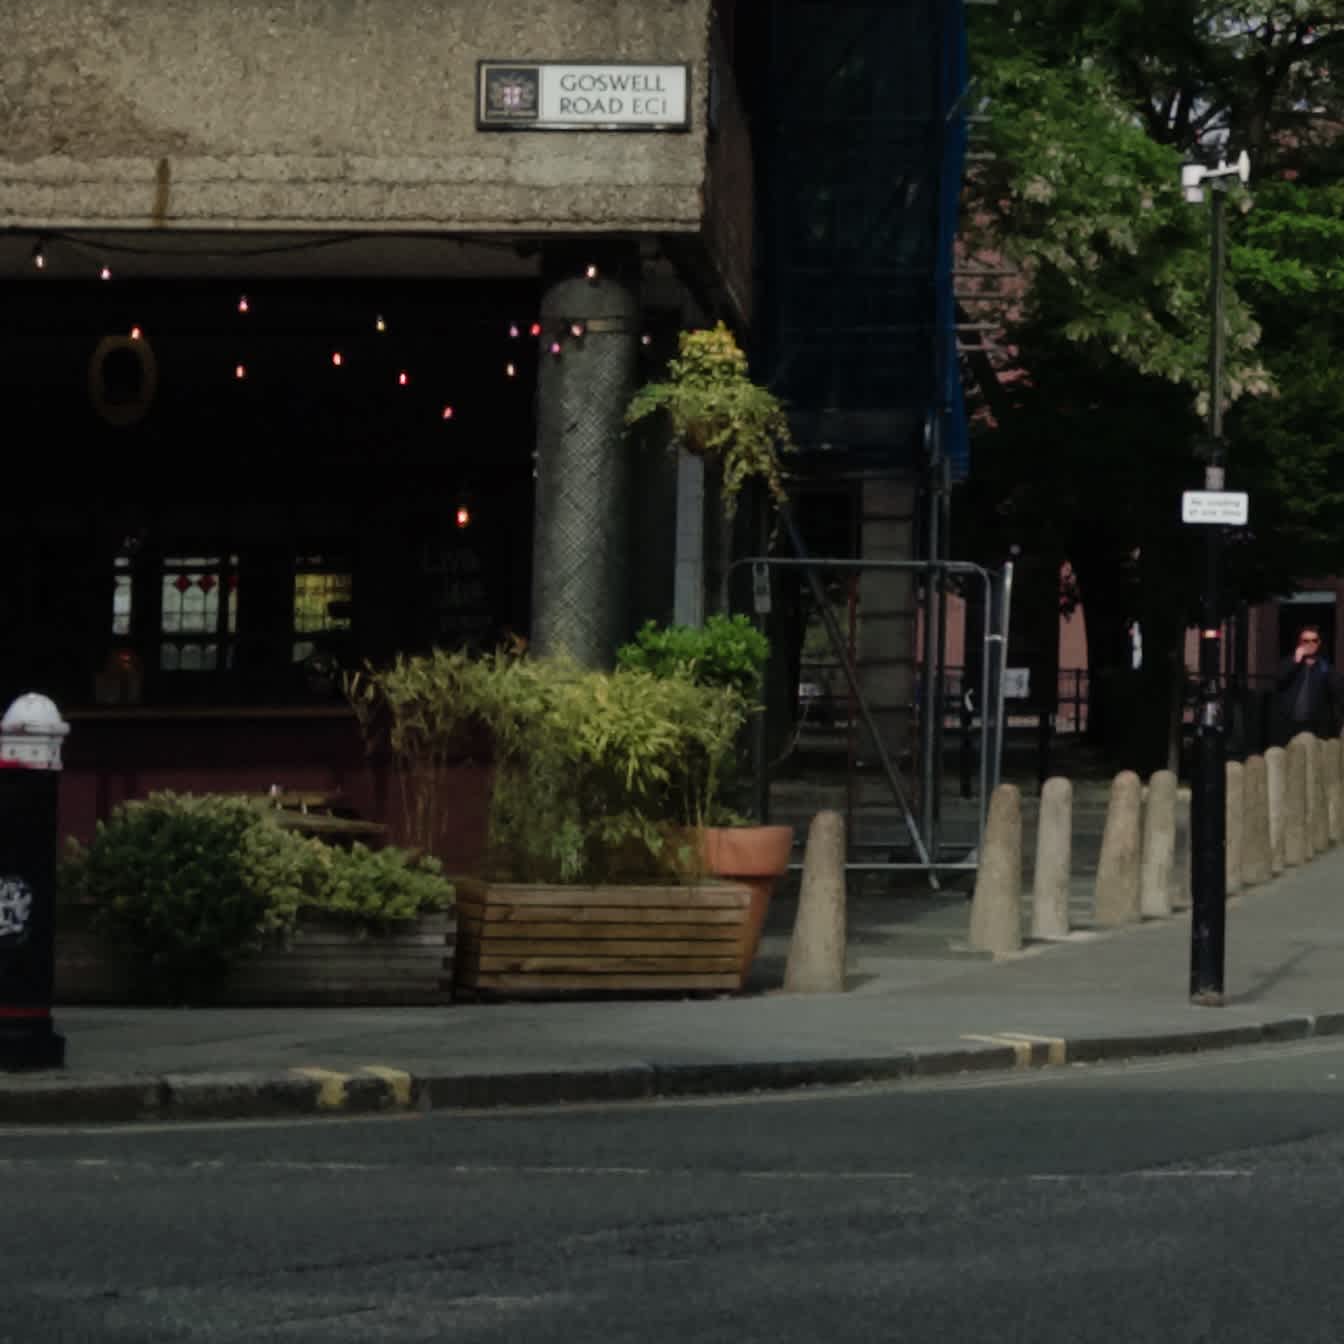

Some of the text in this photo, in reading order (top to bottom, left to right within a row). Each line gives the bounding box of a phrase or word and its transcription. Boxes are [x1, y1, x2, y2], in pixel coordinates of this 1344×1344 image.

[560, 73, 666, 92] GOSWELL
[560, 96, 667, 115] ROAD EC1
